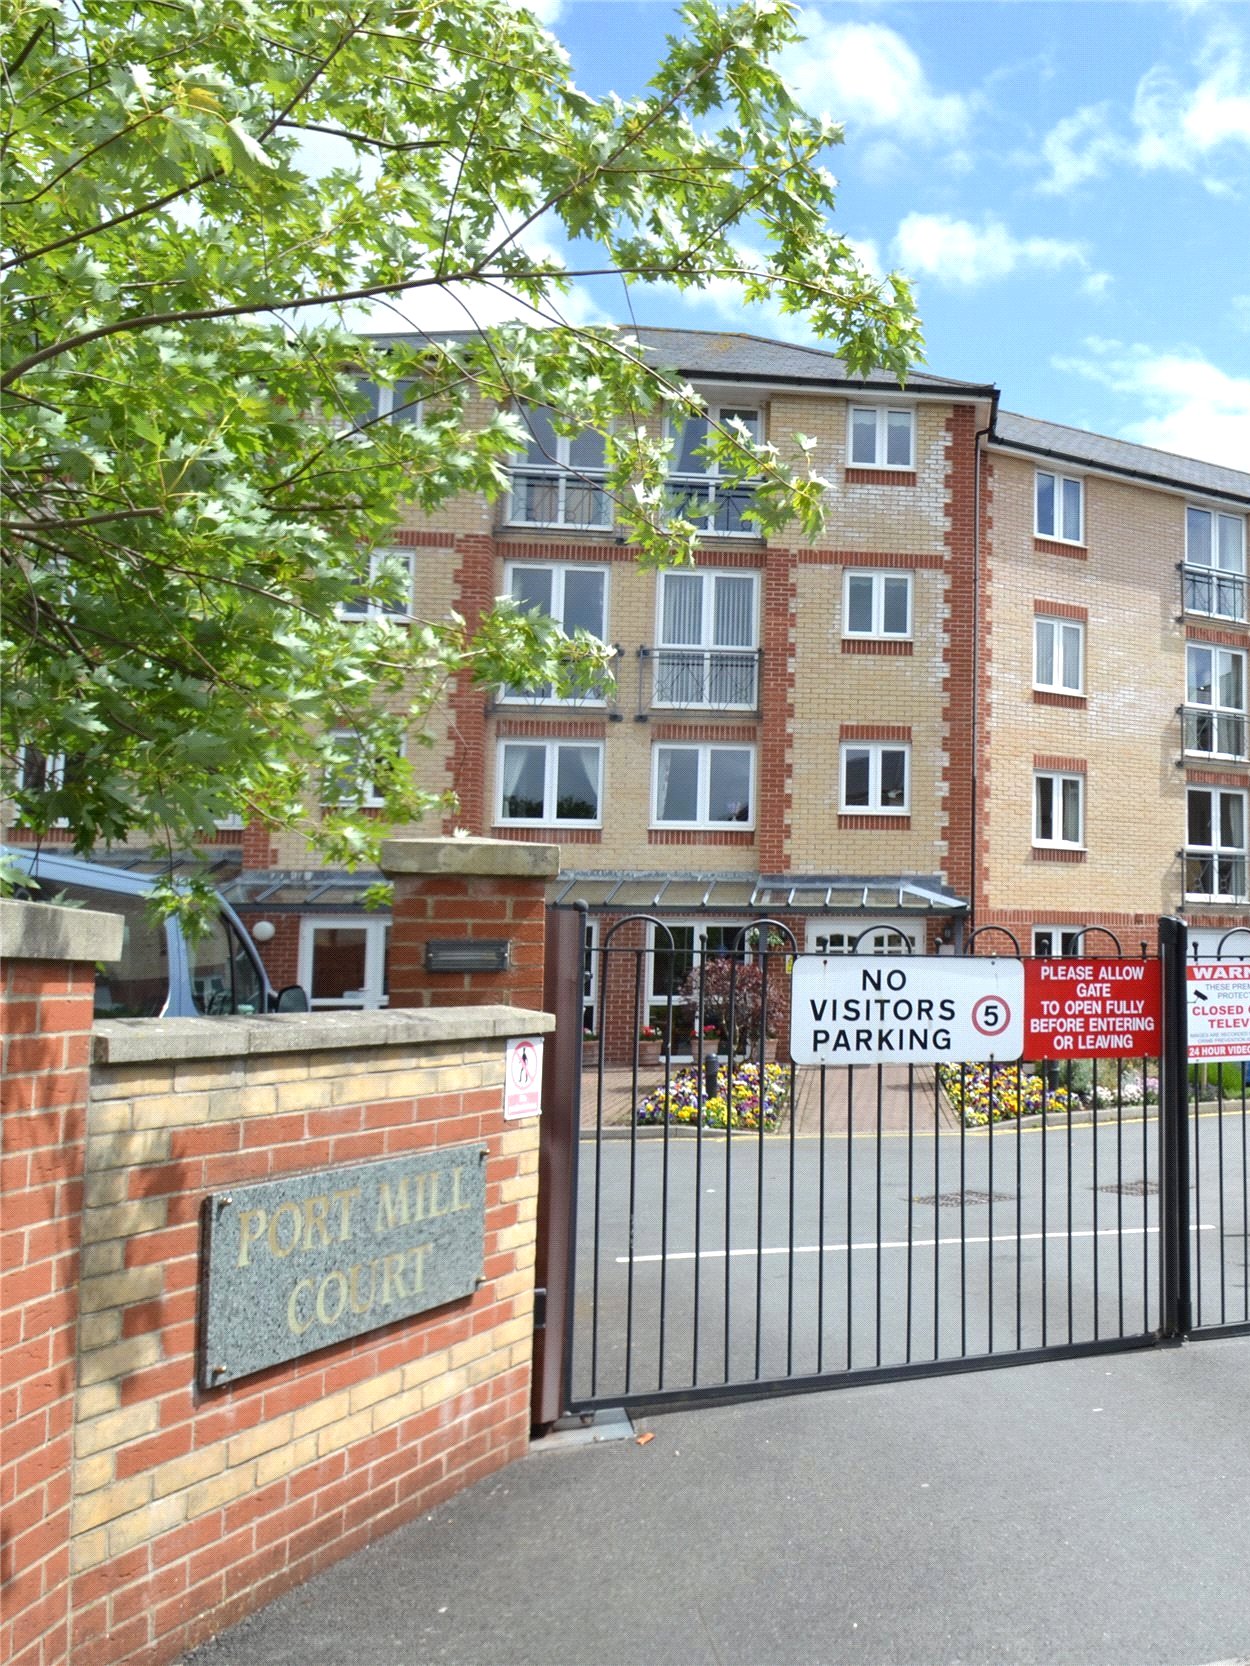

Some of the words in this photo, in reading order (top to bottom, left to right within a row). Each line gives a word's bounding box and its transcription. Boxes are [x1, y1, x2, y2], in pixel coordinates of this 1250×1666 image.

[862, 969, 906, 991] NO
[1041, 966, 1093, 980] PLEASE
[1099, 966, 1144, 980] ALLOW
[1076, 983, 1111, 997] GATE
[1206, 983, 1230, 991] THESE
[810, 999, 956, 1021] VISITORS
[983, 1005, 999, 1026] 5
[1041, 1000, 1060, 1015] TO
[1064, 1000, 1102, 1014] OPEN
[1106, 1000, 1145, 1014] FULLY
[1192, 1005, 1244, 1016] CLOSED
[1030, 1018, 1085, 1033] BEFORE
[1089, 1017, 1154, 1032] ENTERING
[813, 1028, 950, 1052] PARKING
[1053, 1035, 1074, 1050] OR
[1078, 1034, 1133, 1049] LEAVING
[1189, 1047, 1199, 1056] 24
[1202, 1046, 1226, 1055] HOUR
[236, 1187, 360, 1269] PORT
[374, 1167, 472, 1232] MILL
[287, 1243, 434, 1335] COURT
